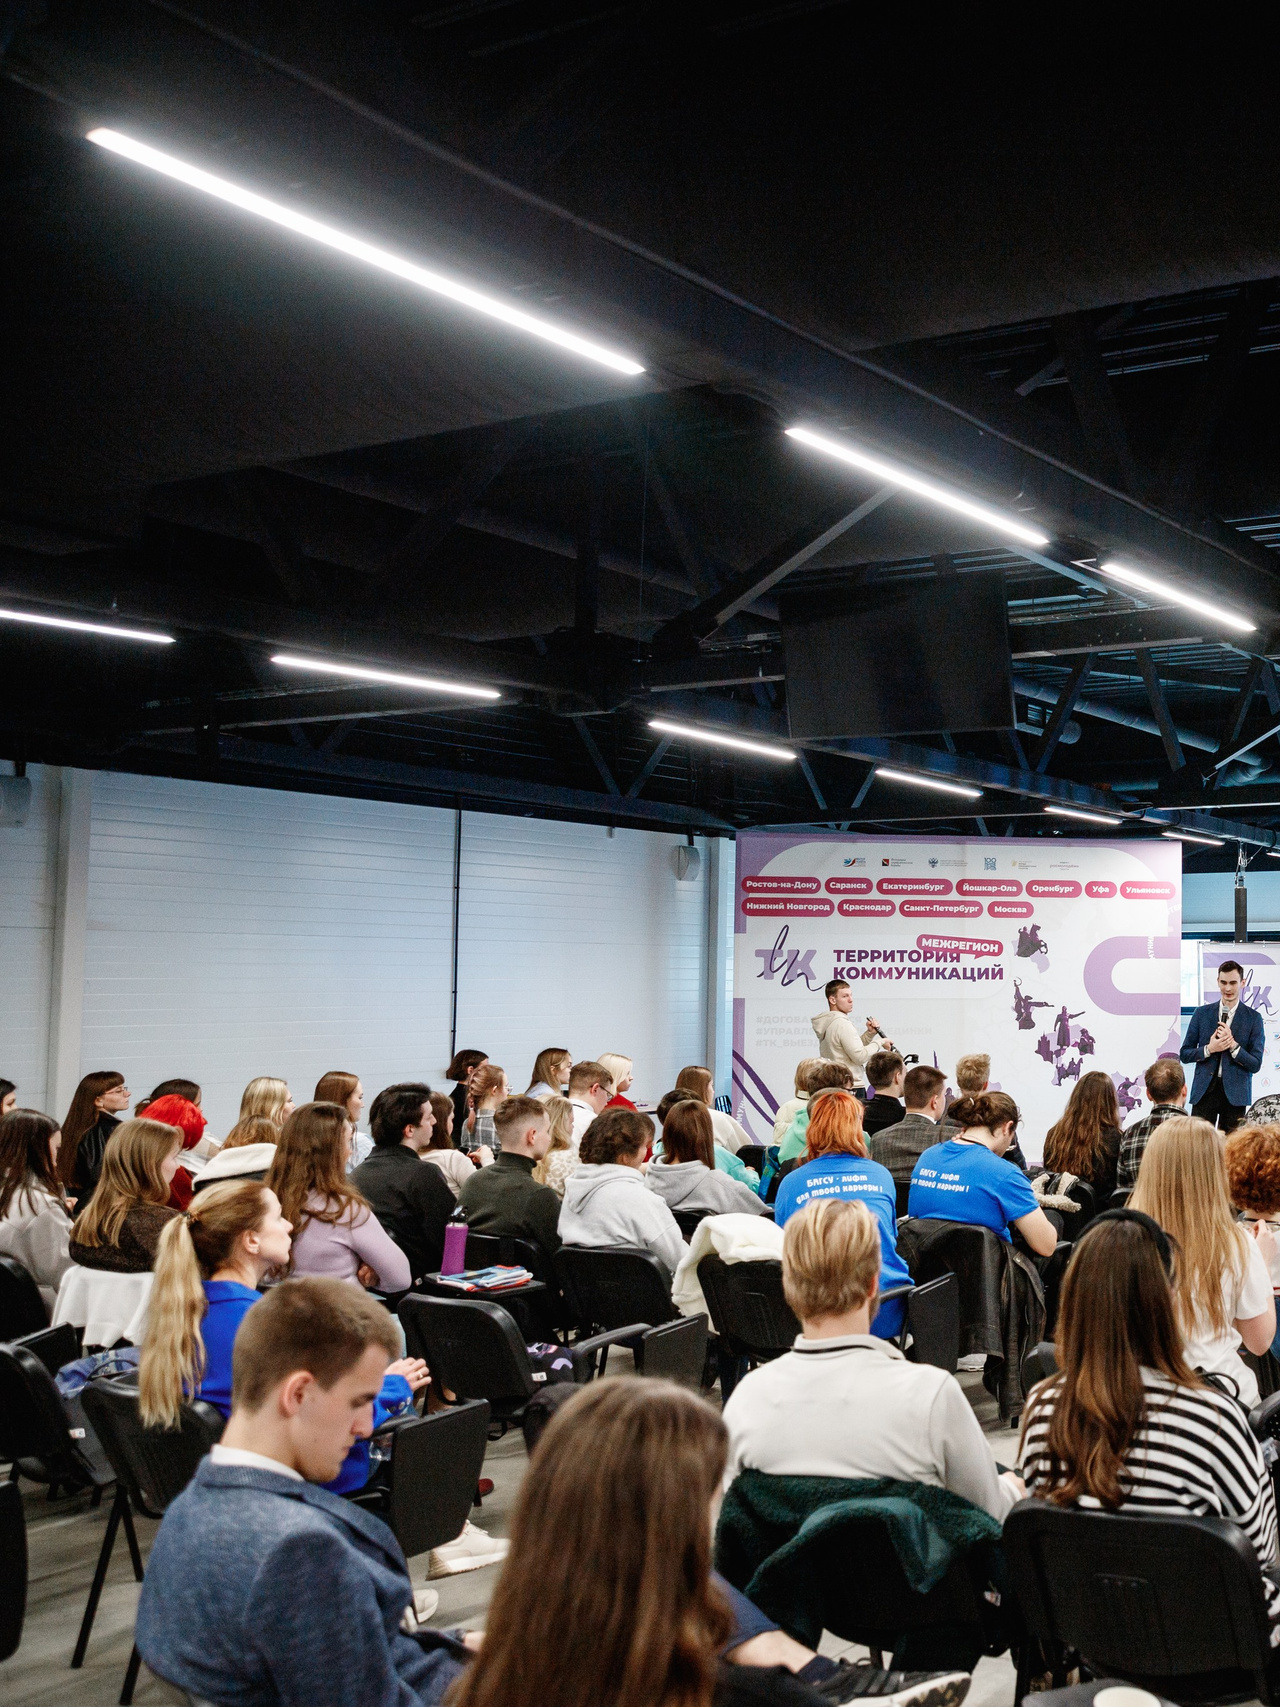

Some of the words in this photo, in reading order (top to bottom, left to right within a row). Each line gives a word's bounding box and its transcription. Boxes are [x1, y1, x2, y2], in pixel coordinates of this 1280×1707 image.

[746, 881, 818, 890] Ростов-на-Дону
[829, 882, 867, 890] Саранск
[882, 883, 945, 892] Екатеринбург
[963, 883, 1017, 893] Йошкар-Ола
[1032, 885, 1075, 893] Оренбург
[1092, 886, 1110, 894] Уфа
[746, 902, 785, 910] Нижний
[787, 903, 831, 912] Новгород
[843, 904, 892, 912] Краснодар
[904, 904, 980, 913] Санкт-Петербург
[921, 937, 999, 953] МЕЖРЕГИОН
[833, 949, 961, 963] ТЕРРИТОРИЯ
[833, 964, 1004, 982] КОММУНИКАЦИЙ
[811, 1185, 840, 1197] твоей
[842, 1184, 879, 1193] карьеры
